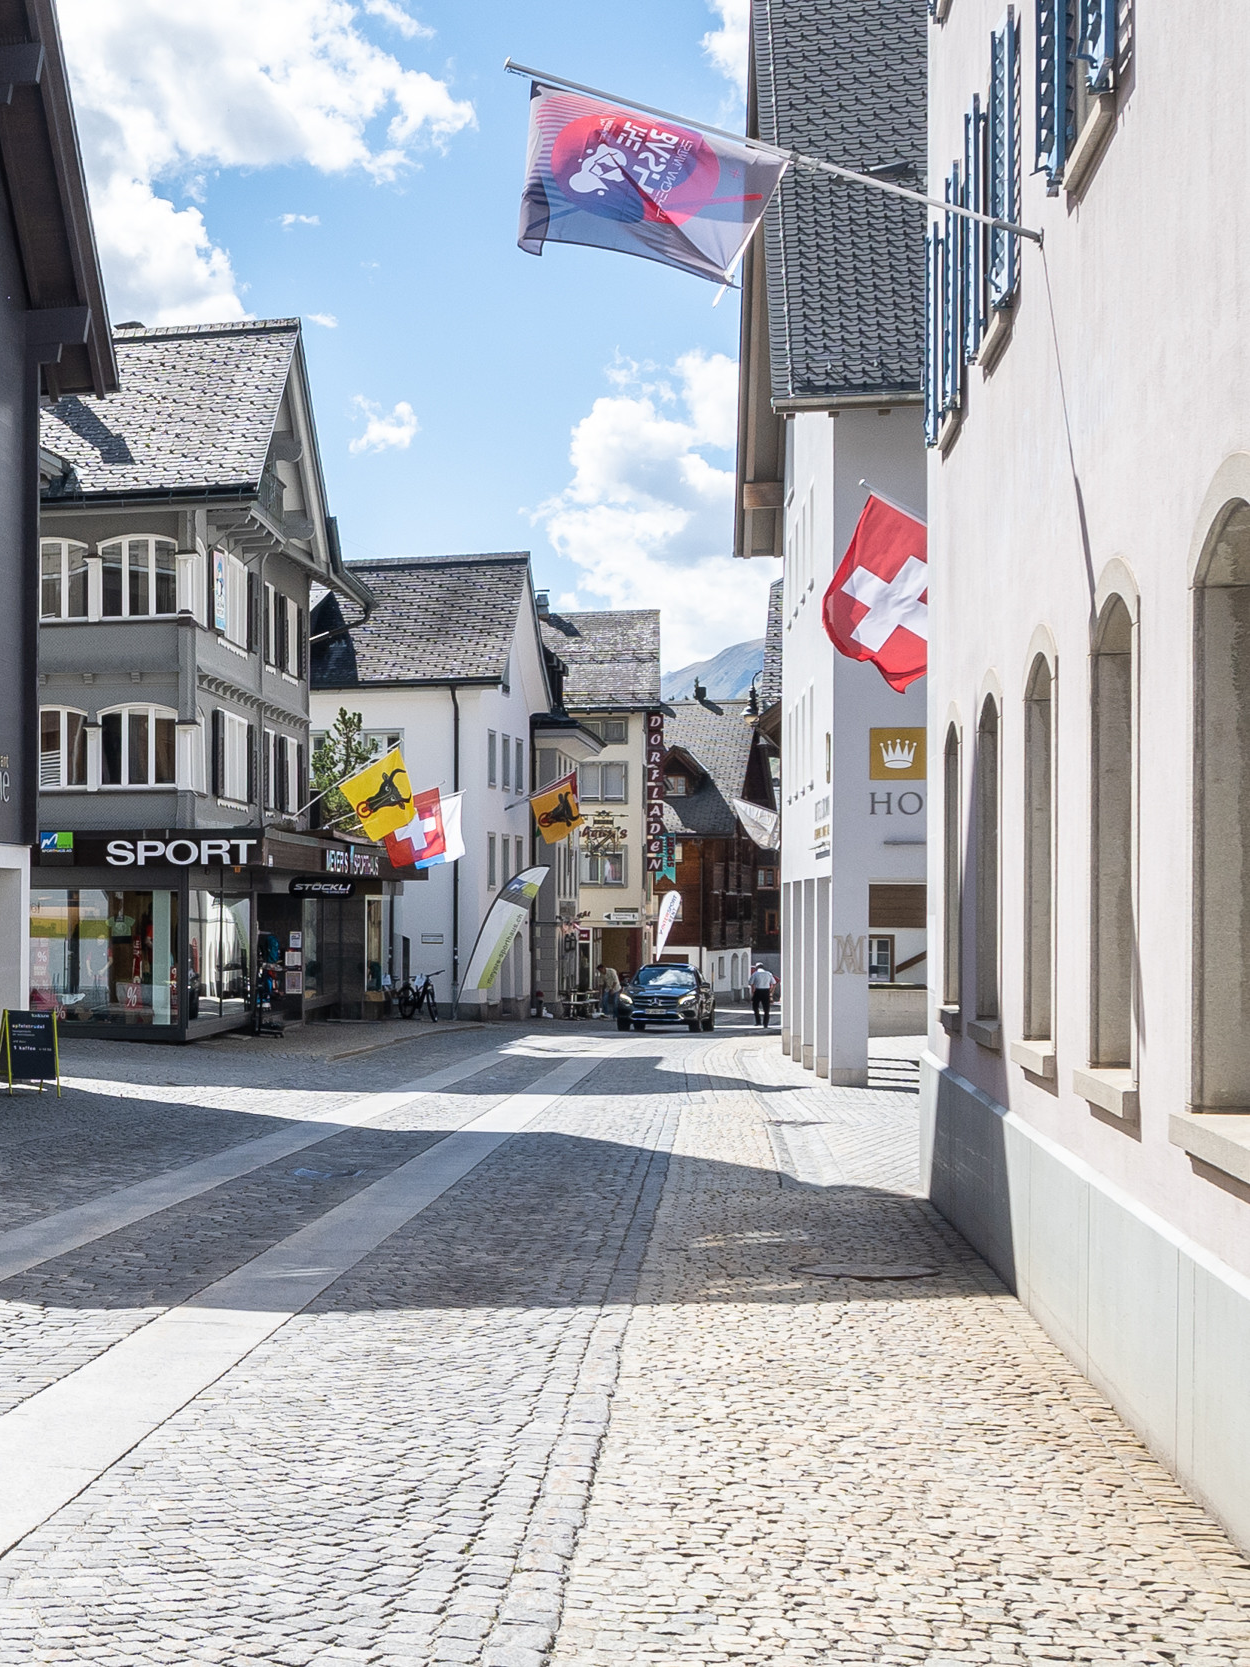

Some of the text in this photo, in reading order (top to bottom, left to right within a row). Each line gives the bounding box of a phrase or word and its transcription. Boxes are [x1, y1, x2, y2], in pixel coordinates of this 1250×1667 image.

[649, 715, 663, 870] DORFLADEN
[869, 791, 925, 816] HO
[105, 839, 258, 866] SPORT
[666, 835, 676, 868] SPORT
[293, 882, 352, 891] STÖCKLI
